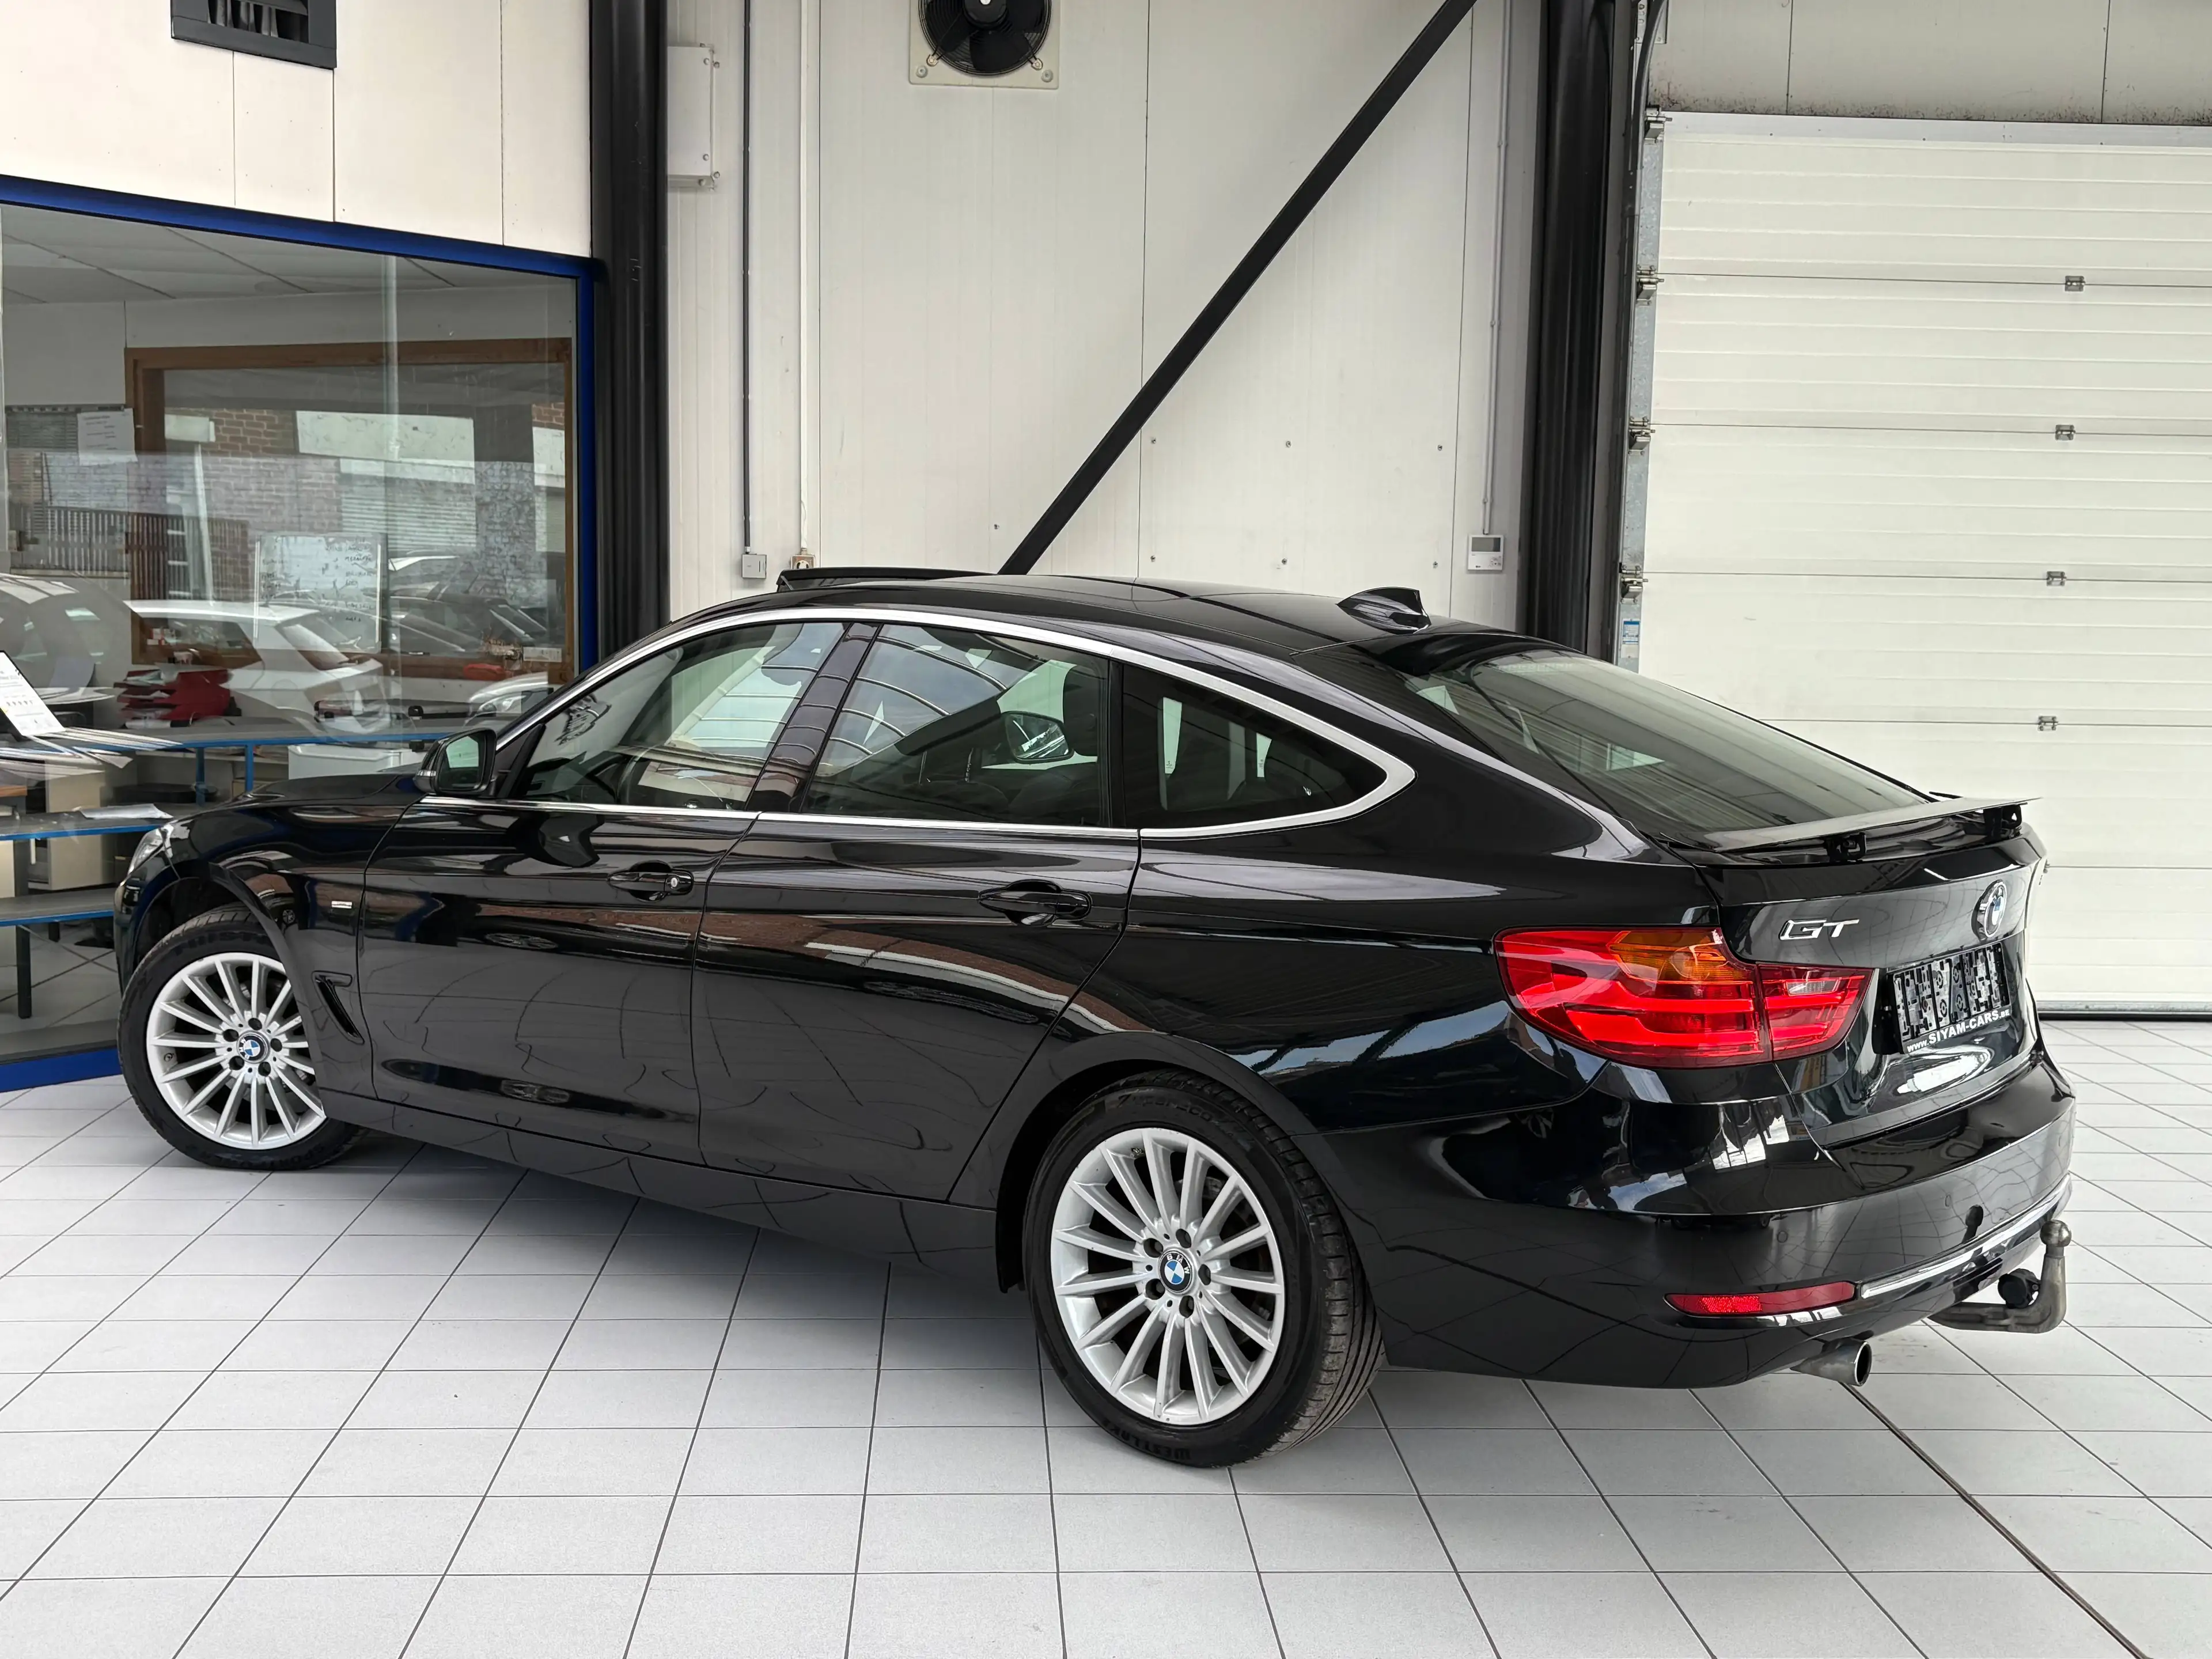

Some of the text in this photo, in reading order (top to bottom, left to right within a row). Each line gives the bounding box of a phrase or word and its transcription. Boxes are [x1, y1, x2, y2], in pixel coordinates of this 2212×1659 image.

[1779, 919, 1859, 940] GT
[1907, 1009, 2010, 1053] www.SIYAM-CARS.BE
[1166, 1253, 1190, 1274] BMW
